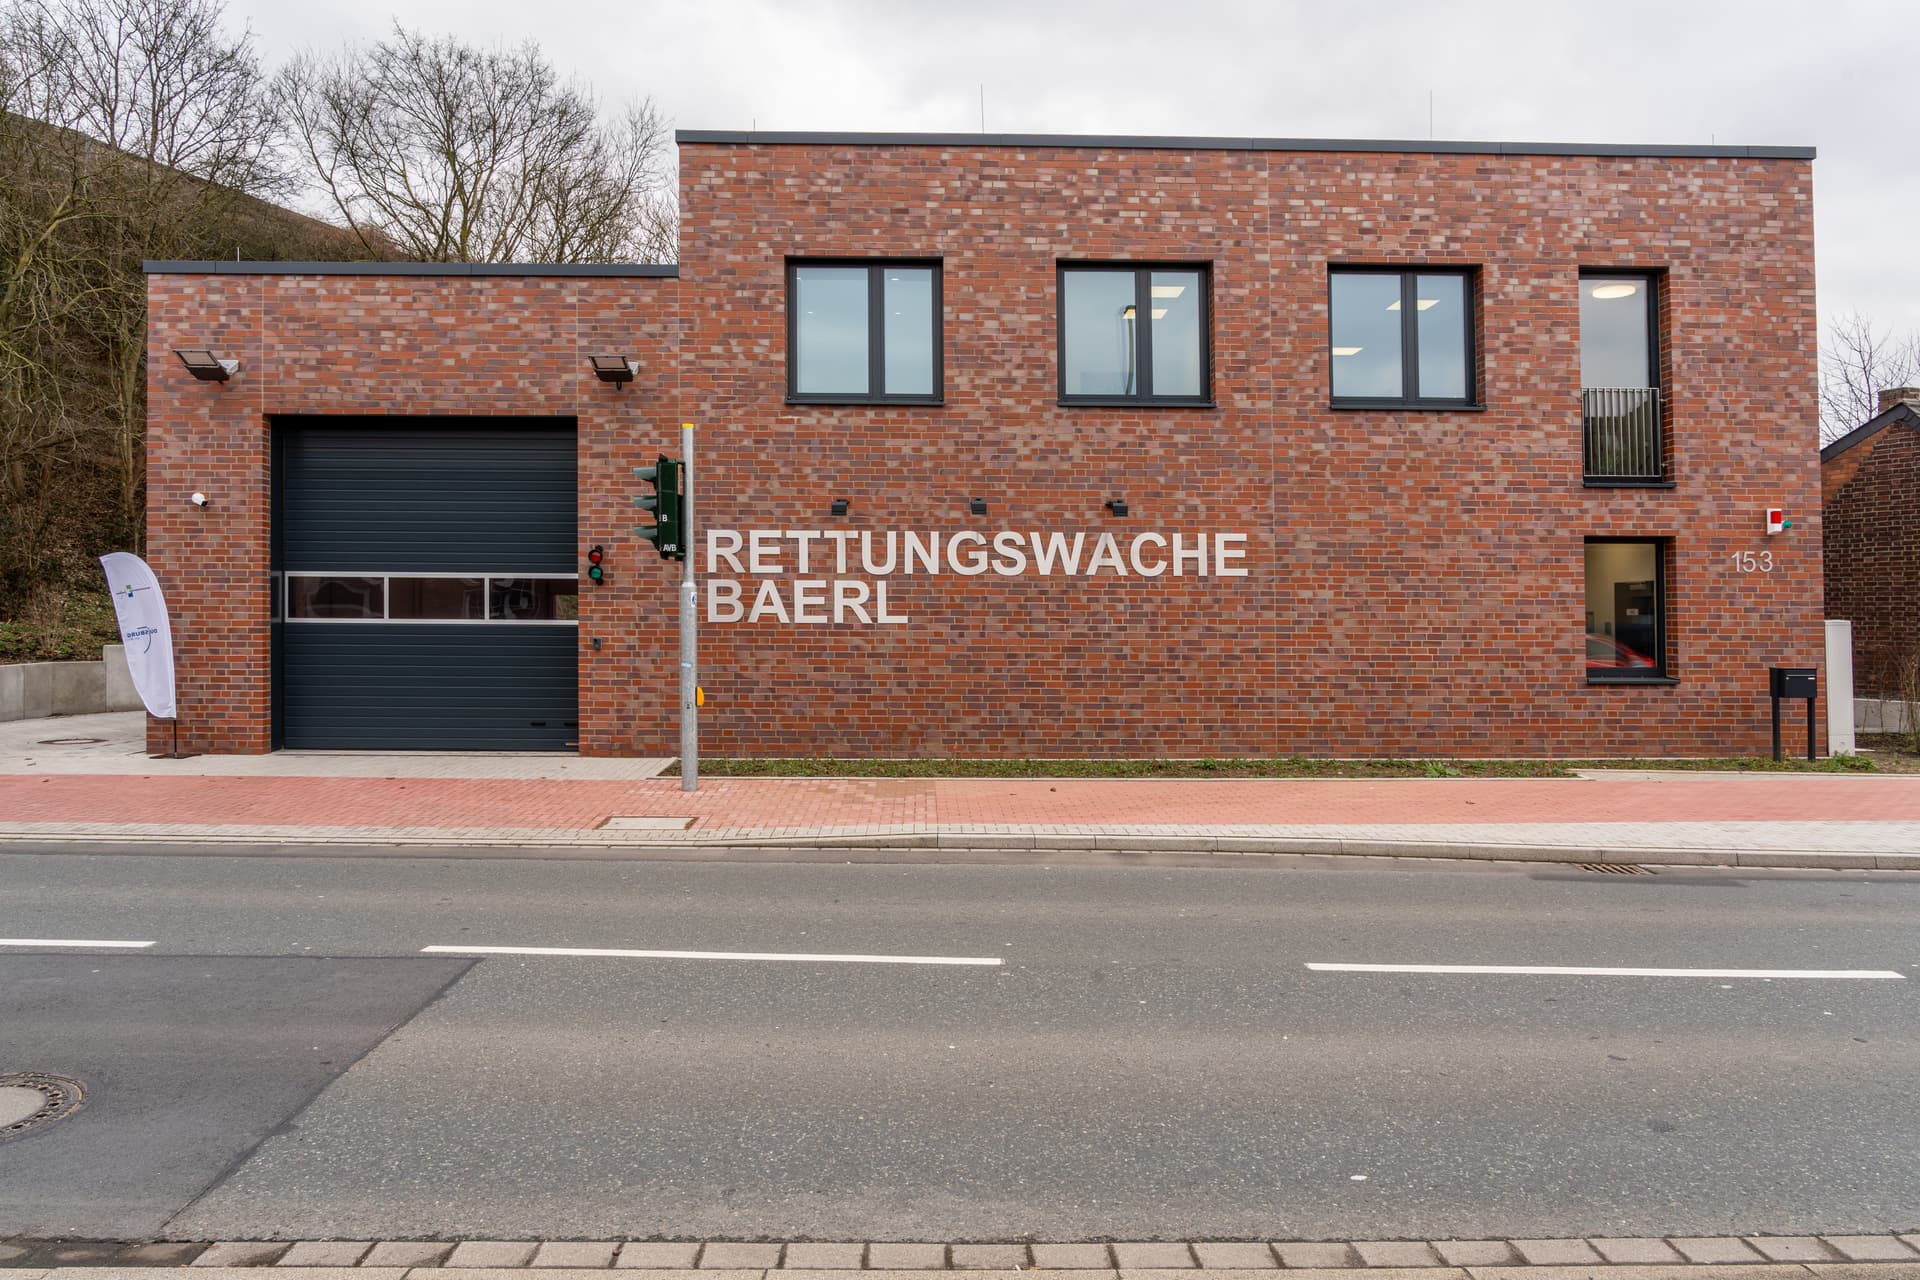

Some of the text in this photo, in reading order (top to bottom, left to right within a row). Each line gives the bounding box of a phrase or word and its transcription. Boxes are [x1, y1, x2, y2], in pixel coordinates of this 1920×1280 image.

[706, 528, 1249, 577] RETTUNGSWACHE
[1731, 550, 1773, 572] 153
[706, 579, 909, 623] BAERL
